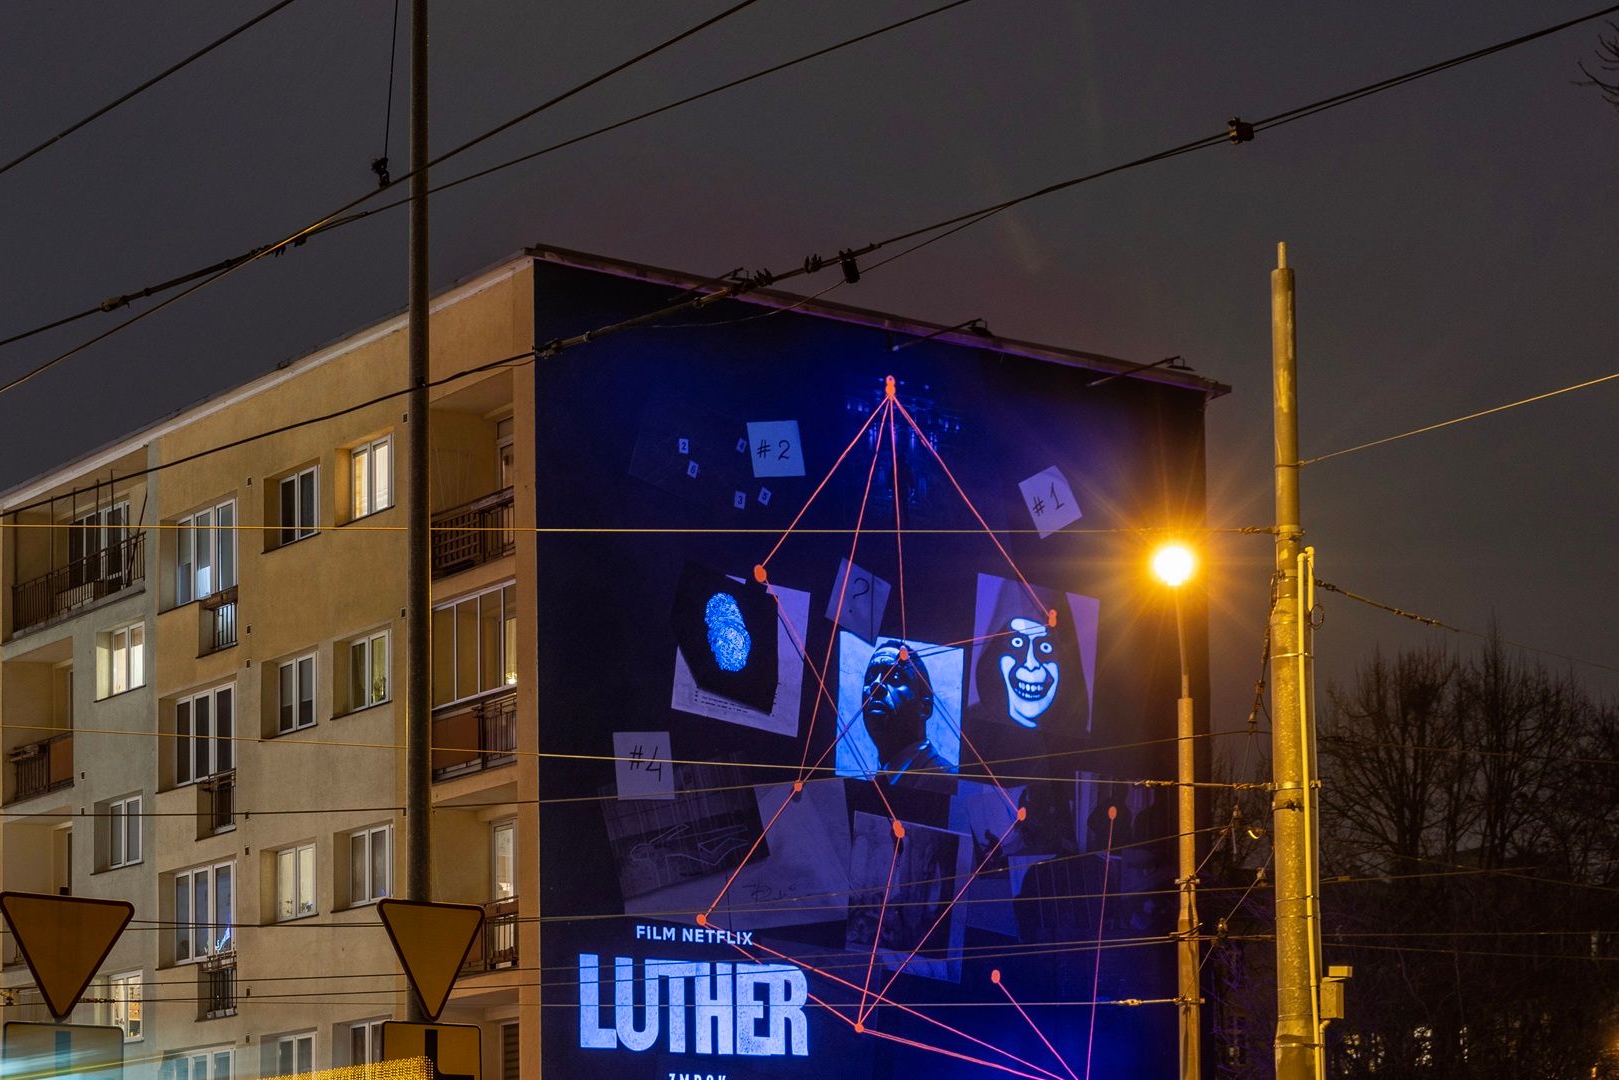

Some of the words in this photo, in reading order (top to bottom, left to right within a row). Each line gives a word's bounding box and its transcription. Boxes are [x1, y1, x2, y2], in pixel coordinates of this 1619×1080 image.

[636, 925, 676, 942] FILM
[682, 927, 753, 946] NETFLIX
[579, 953, 809, 1057] LUTHER
